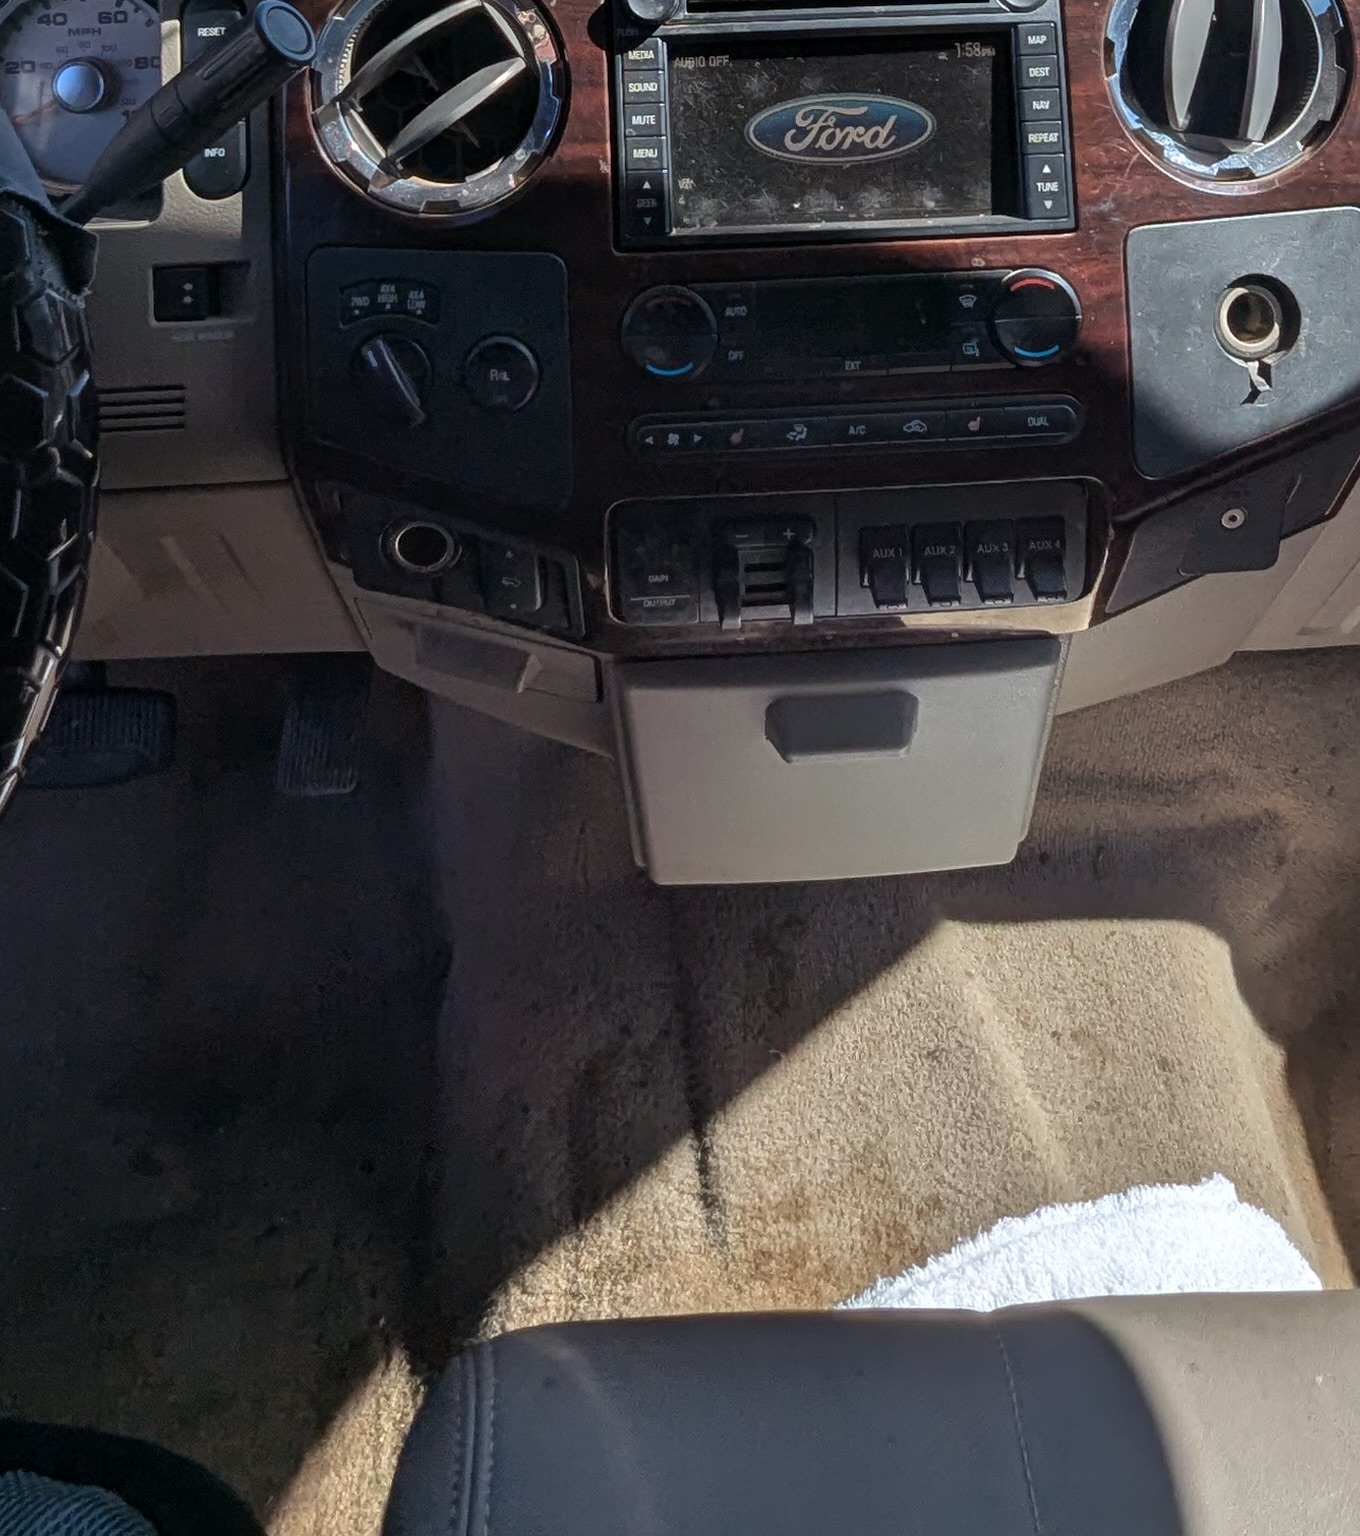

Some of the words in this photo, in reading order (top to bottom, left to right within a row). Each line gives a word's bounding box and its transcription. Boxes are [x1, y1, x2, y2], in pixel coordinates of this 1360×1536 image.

[37, 13, 68, 26] 40
[98, 11, 128, 24] 60
[68, 28, 102, 37] MPH
[197, 27, 227, 37] RESET
[1028, 35, 1047, 45] MAP
[628, 50, 655, 60] MEDIA
[673, 56, 706, 68] AUDIO
[708, 55, 730, 67] OFF
[5, 61, 36, 74] 20
[1029, 67, 1050, 77] DEST
[628, 82, 658, 93] SOUND
[1032, 100, 1050, 110] NAV
[631, 114, 656, 125] MUTE
[784, 105, 897, 152] Ford
[1028, 133, 1059, 143] REPEAT
[204, 148, 226, 158] INFO
[633, 148, 658, 158] MENU
[1036, 181, 1059, 192] TUNE
[724, 305, 747, 317] AUTO
[844, 360, 861, 371] EXT
[1027, 416, 1049, 427] DUAL
[848, 424, 867, 435] A/C
[924, 545, 948, 556] AUX
[977, 543, 1000, 554] AUX
[1029, 540, 1052, 551] AUX
[873, 548, 895, 559] AUX
